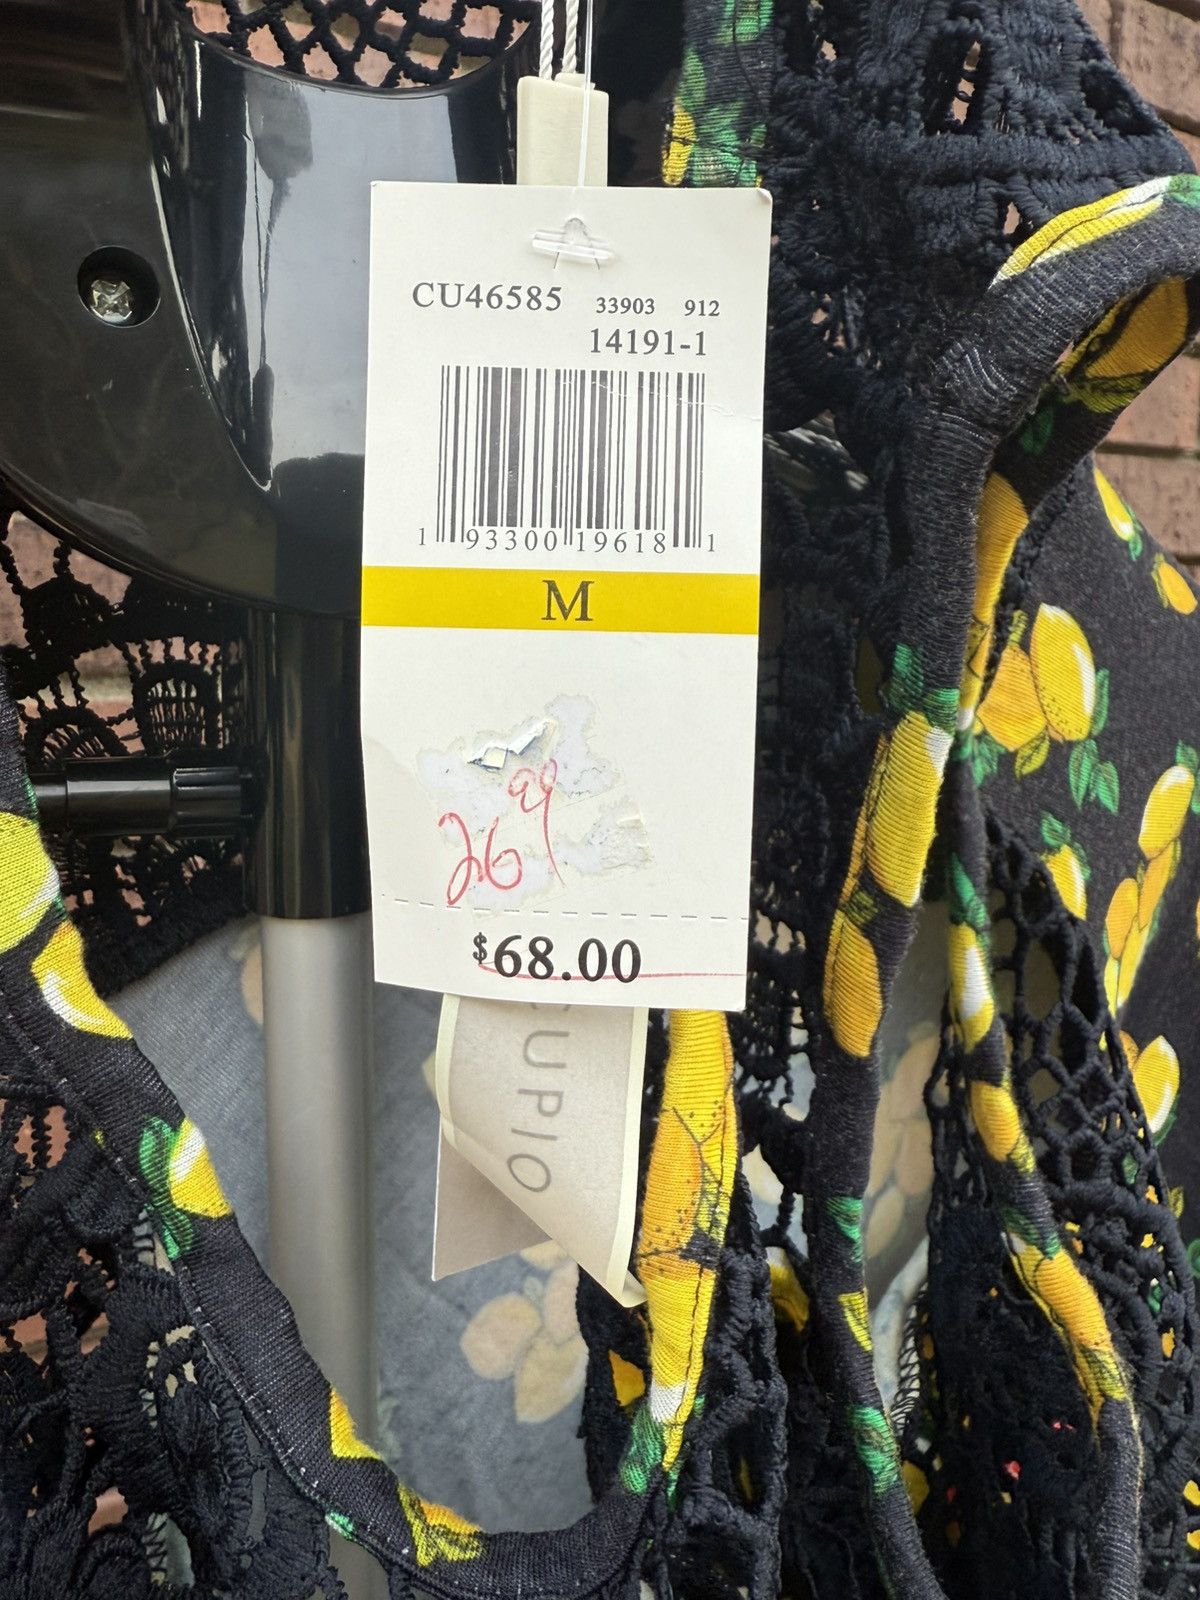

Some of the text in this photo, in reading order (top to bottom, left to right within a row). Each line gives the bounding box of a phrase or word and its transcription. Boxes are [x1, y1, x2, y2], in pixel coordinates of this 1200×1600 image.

[412, 282, 720, 317] CU46585 33903 912
[590, 328, 707, 356] 14191-1
[541, 580, 594, 622] M
[472, 932, 642, 983] $68.00
[506, 1003, 571, 1193] UPIO
